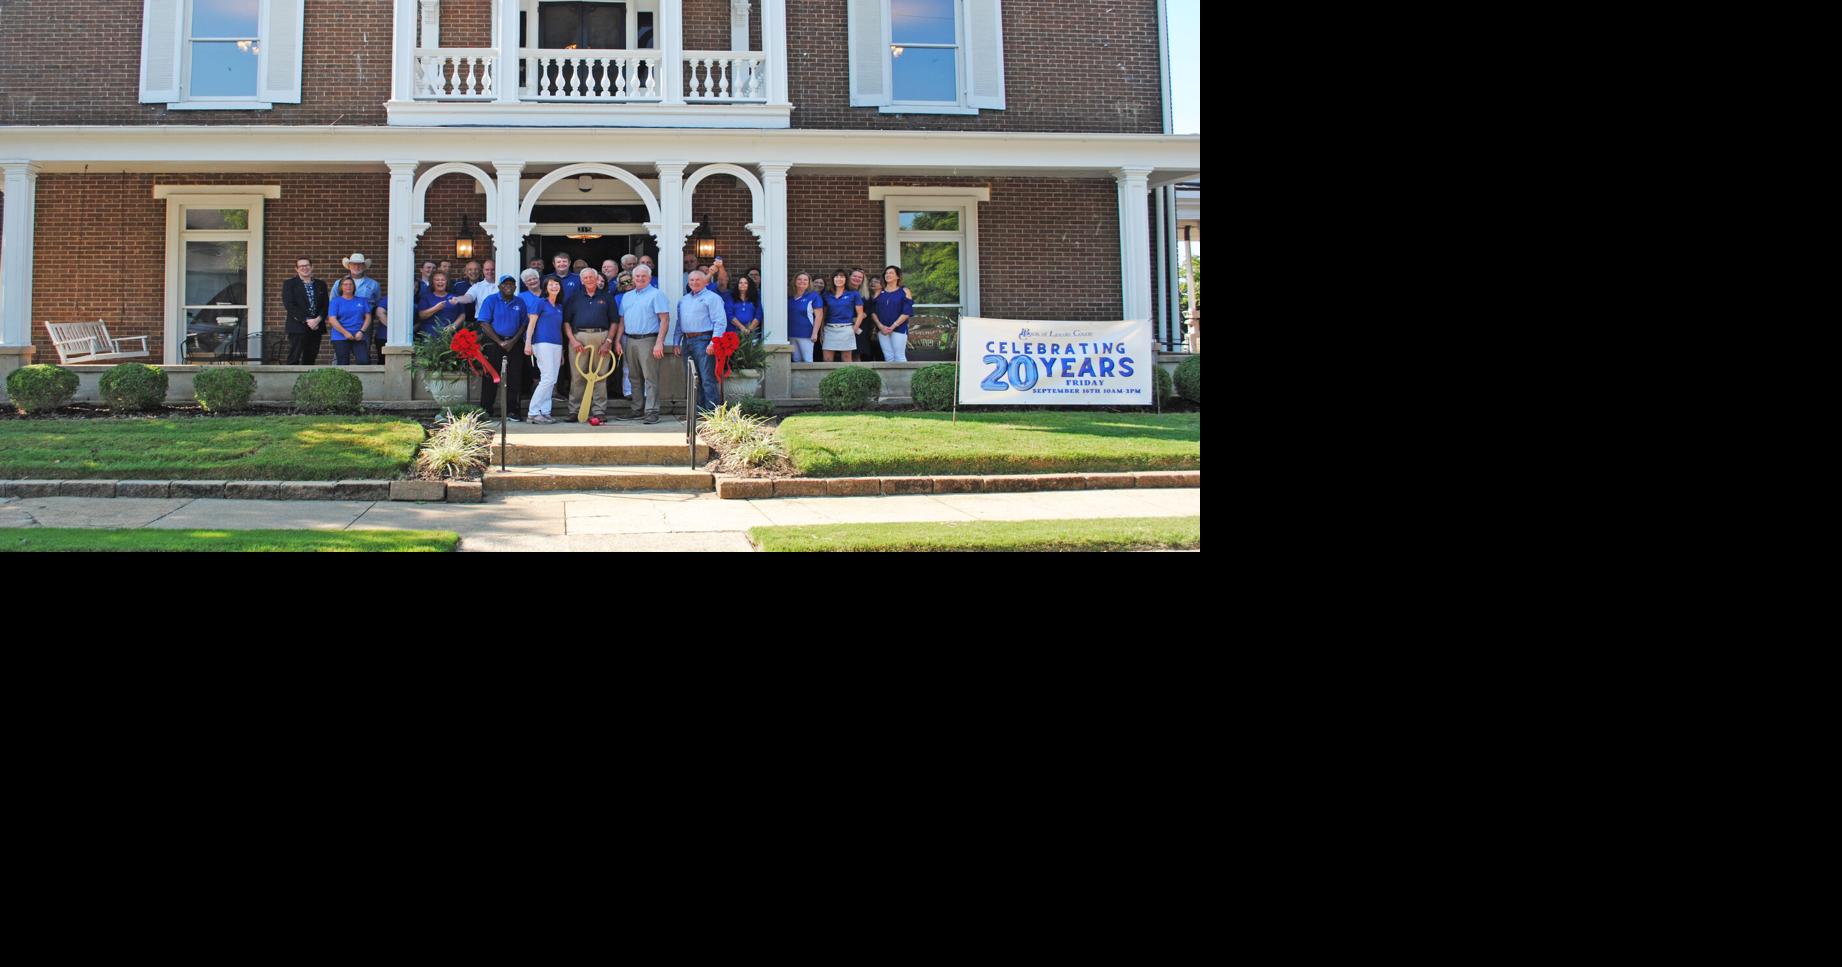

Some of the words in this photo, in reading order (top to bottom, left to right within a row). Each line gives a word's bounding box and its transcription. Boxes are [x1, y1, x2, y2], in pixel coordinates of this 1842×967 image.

[986, 341, 1126, 355] CELEBRATING
[981, 354, 1039, 391] 20
[1039, 357, 1135, 378] YEARS
